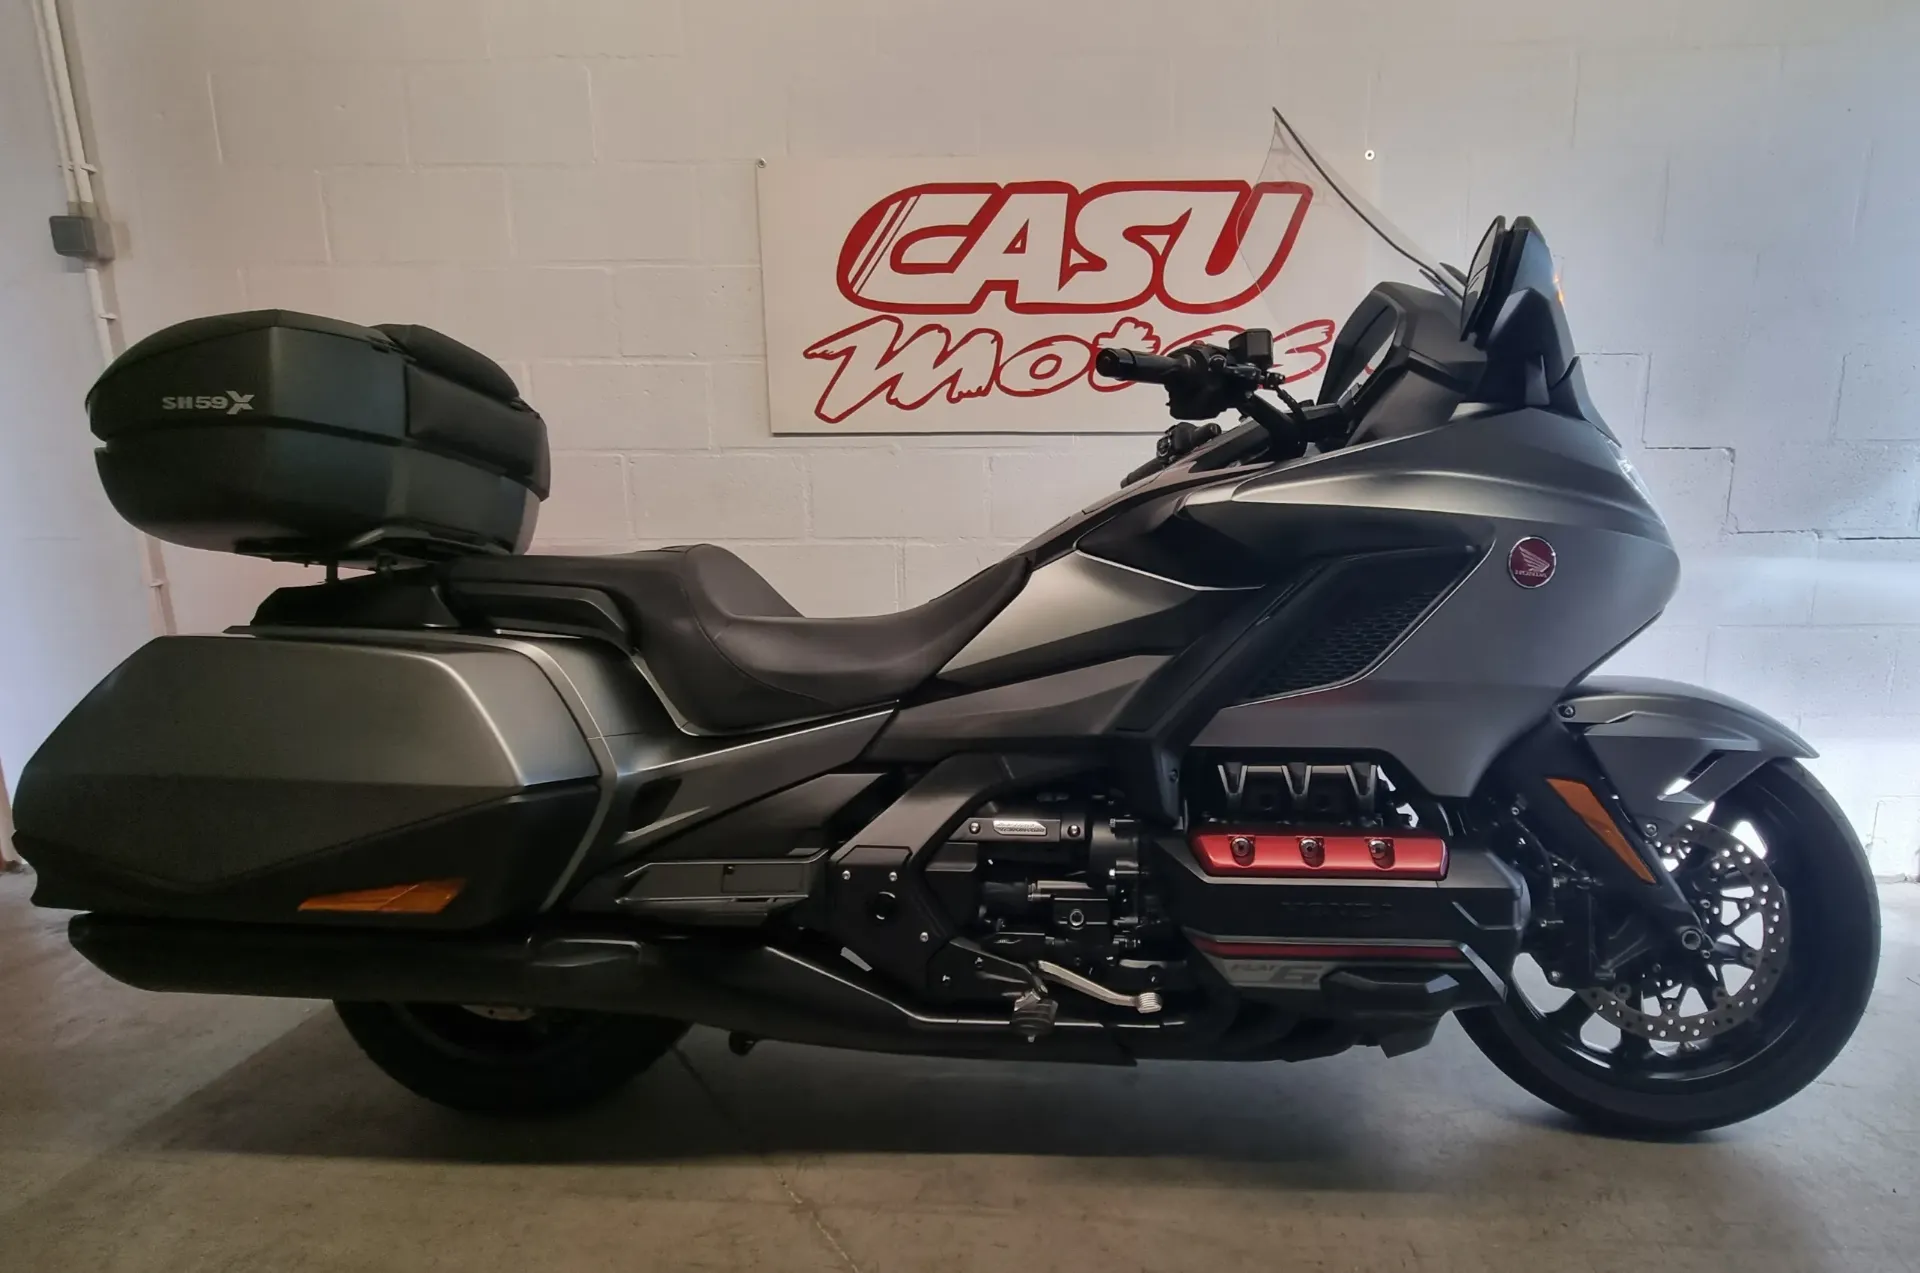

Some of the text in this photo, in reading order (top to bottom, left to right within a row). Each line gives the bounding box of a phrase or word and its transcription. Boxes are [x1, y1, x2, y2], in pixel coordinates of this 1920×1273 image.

[836, 180, 1314, 314] CASU
[162, 390, 255, 415] SH59X
[802, 315, 1336, 423] Mots
